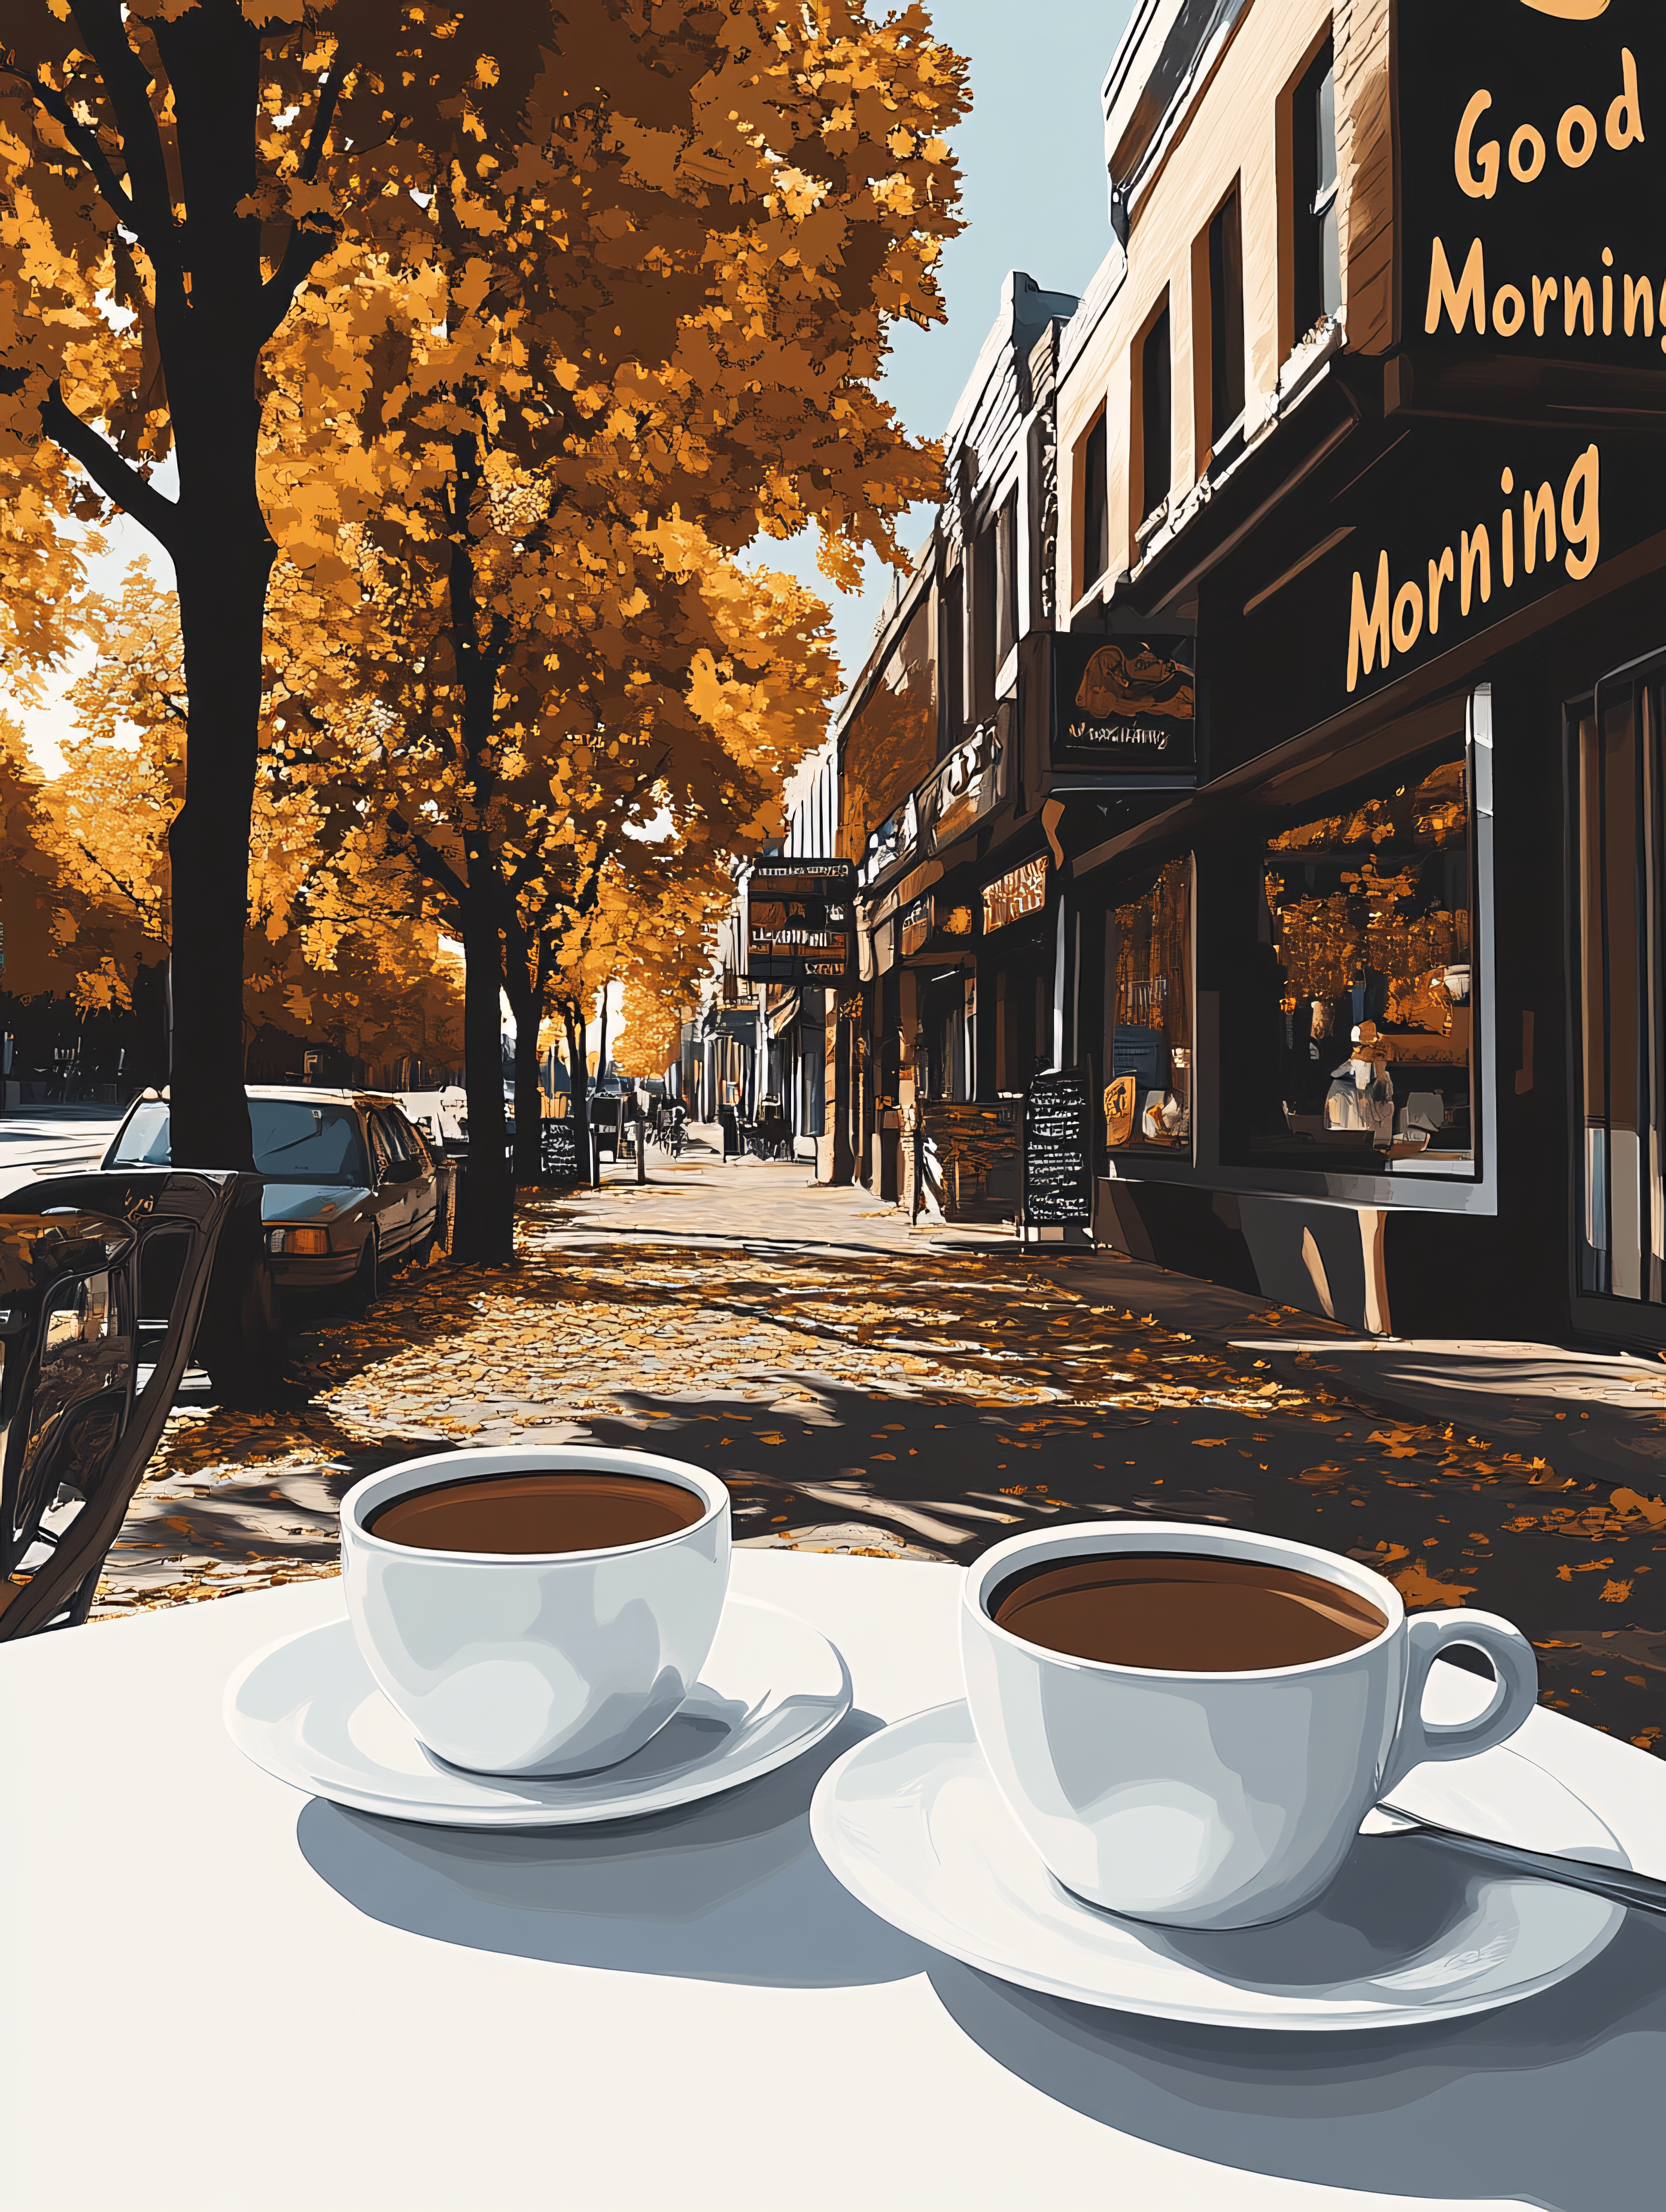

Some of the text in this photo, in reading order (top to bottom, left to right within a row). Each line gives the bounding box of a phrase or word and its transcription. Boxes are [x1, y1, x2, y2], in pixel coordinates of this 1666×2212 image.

[1454, 47, 1645, 199] Good
[1424, 236, 1666, 354] Mornin
[1346, 443, 1600, 692] Morning
